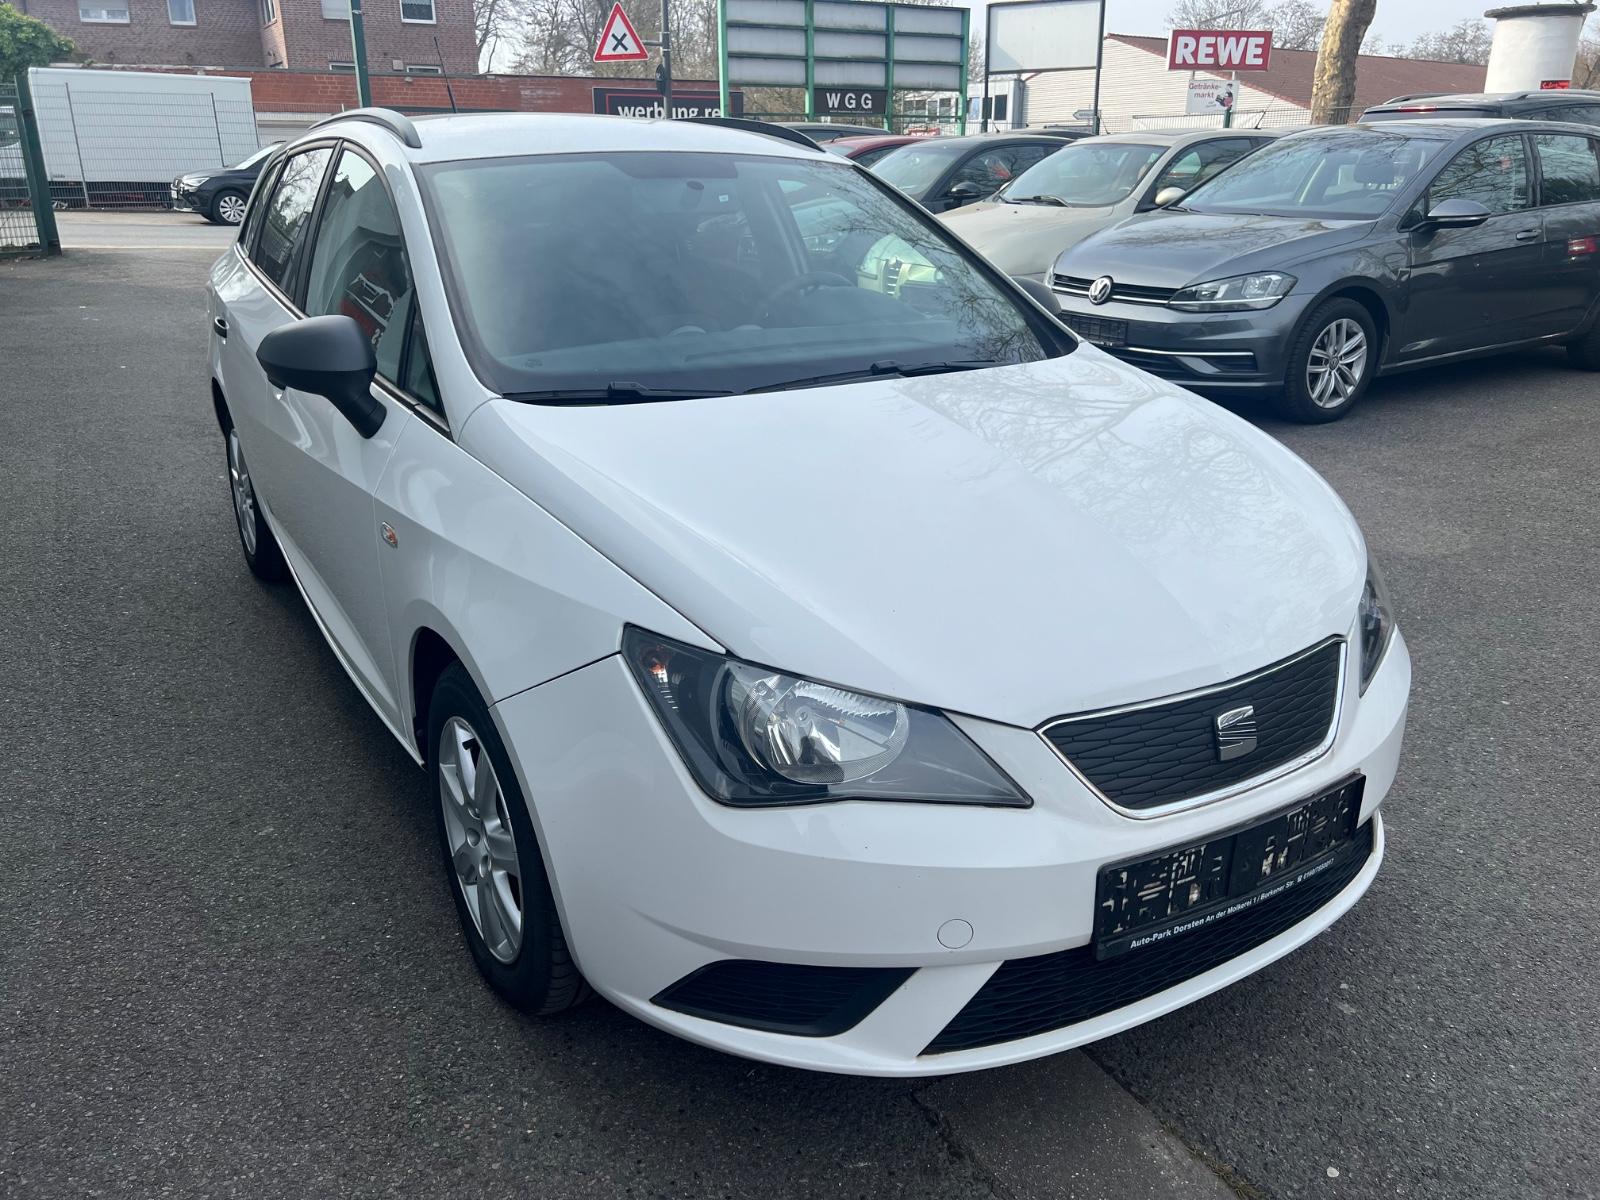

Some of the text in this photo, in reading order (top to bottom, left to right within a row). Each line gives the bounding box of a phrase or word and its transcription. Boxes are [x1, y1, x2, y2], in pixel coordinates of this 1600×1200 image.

[1174, 35, 1265, 66] REWE
[1188, 82, 1222, 90] Getränke-
[1130, 929, 1172, 949] Auto-Park
[1173, 918, 1205, 934] Dorsten
[1205, 914, 1215, 923] An
[1215, 909, 1227, 919] der
